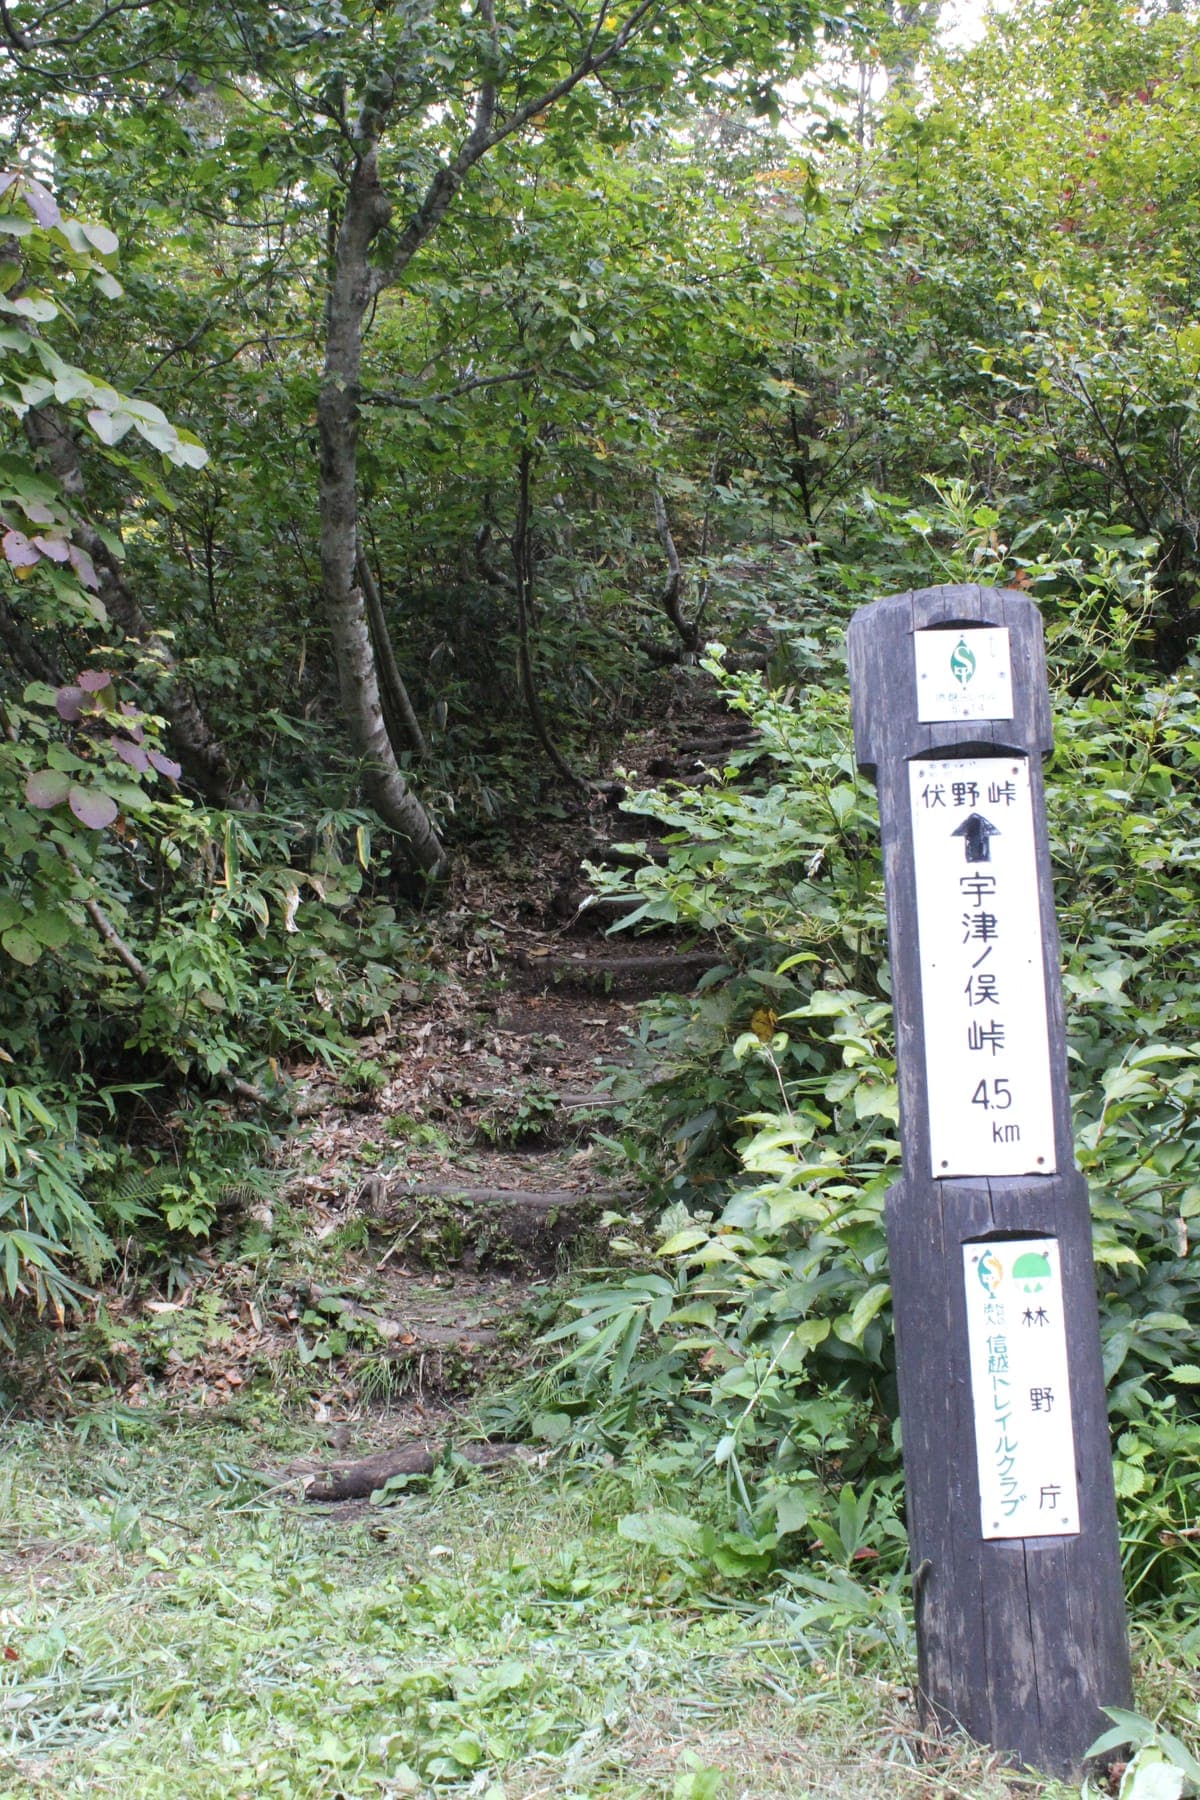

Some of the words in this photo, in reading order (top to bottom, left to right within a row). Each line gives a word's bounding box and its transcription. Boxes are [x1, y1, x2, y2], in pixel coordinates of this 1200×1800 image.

[921, 781, 1017, 808] 伏野峠
[959, 871, 1006, 1057] 宇津ノ俣峠
[992, 1121, 1021, 1143] km
[985, 1334, 1028, 1517] 信越トレイルクラブ
